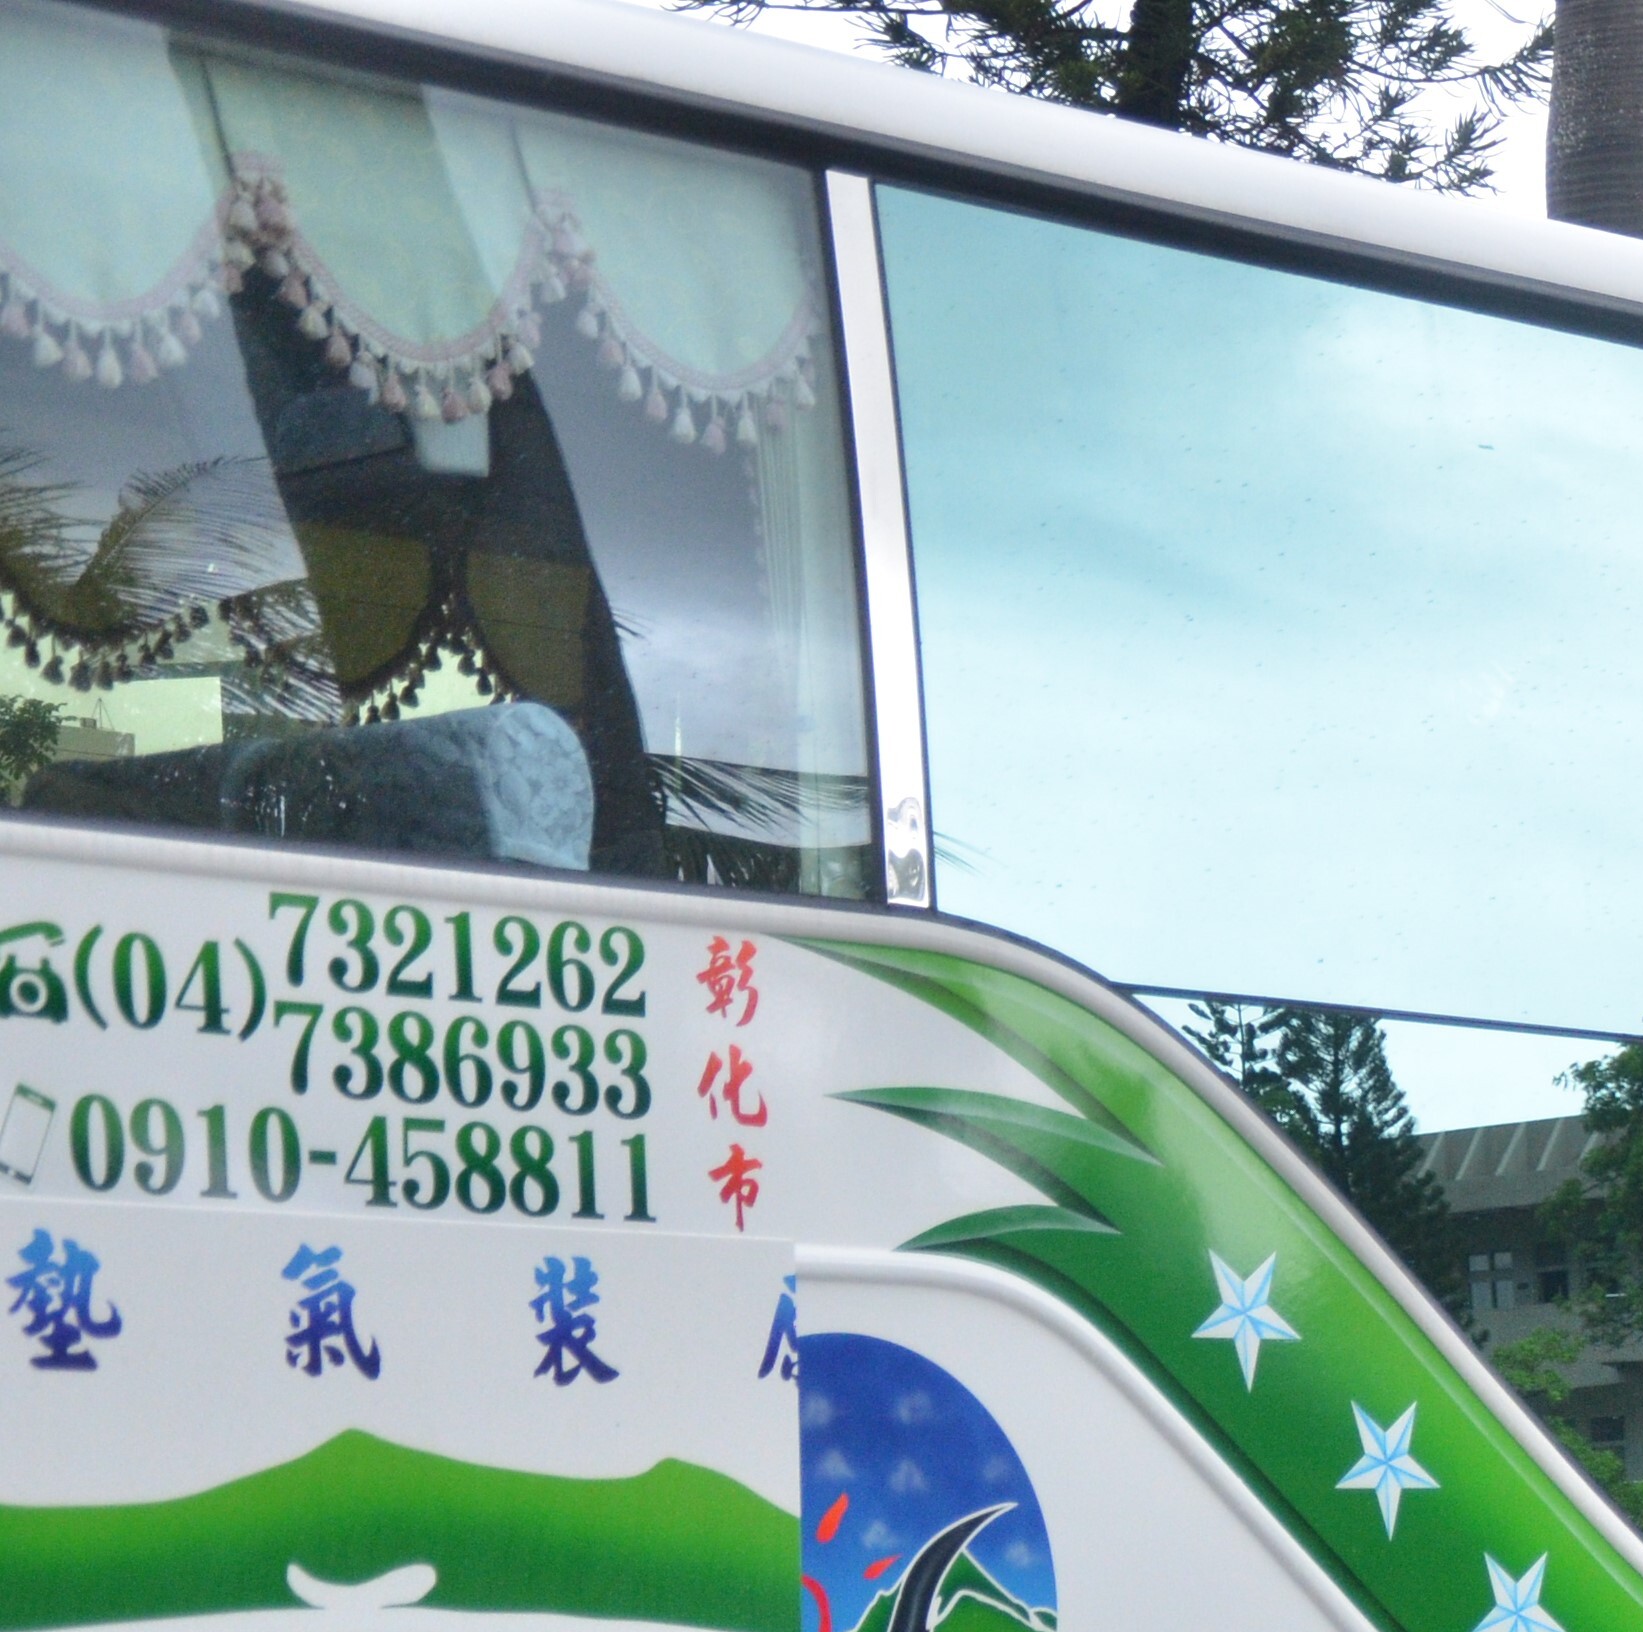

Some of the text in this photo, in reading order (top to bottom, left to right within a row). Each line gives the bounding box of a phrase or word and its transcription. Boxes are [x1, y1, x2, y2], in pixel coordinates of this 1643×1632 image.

[75, 891, 648, 1040] (04) 7321262
[273, 1000, 653, 1120] 7386933
[698, 936, 768, 1232] 彰化市
[69, 1092, 657, 1223] 0910-458811
